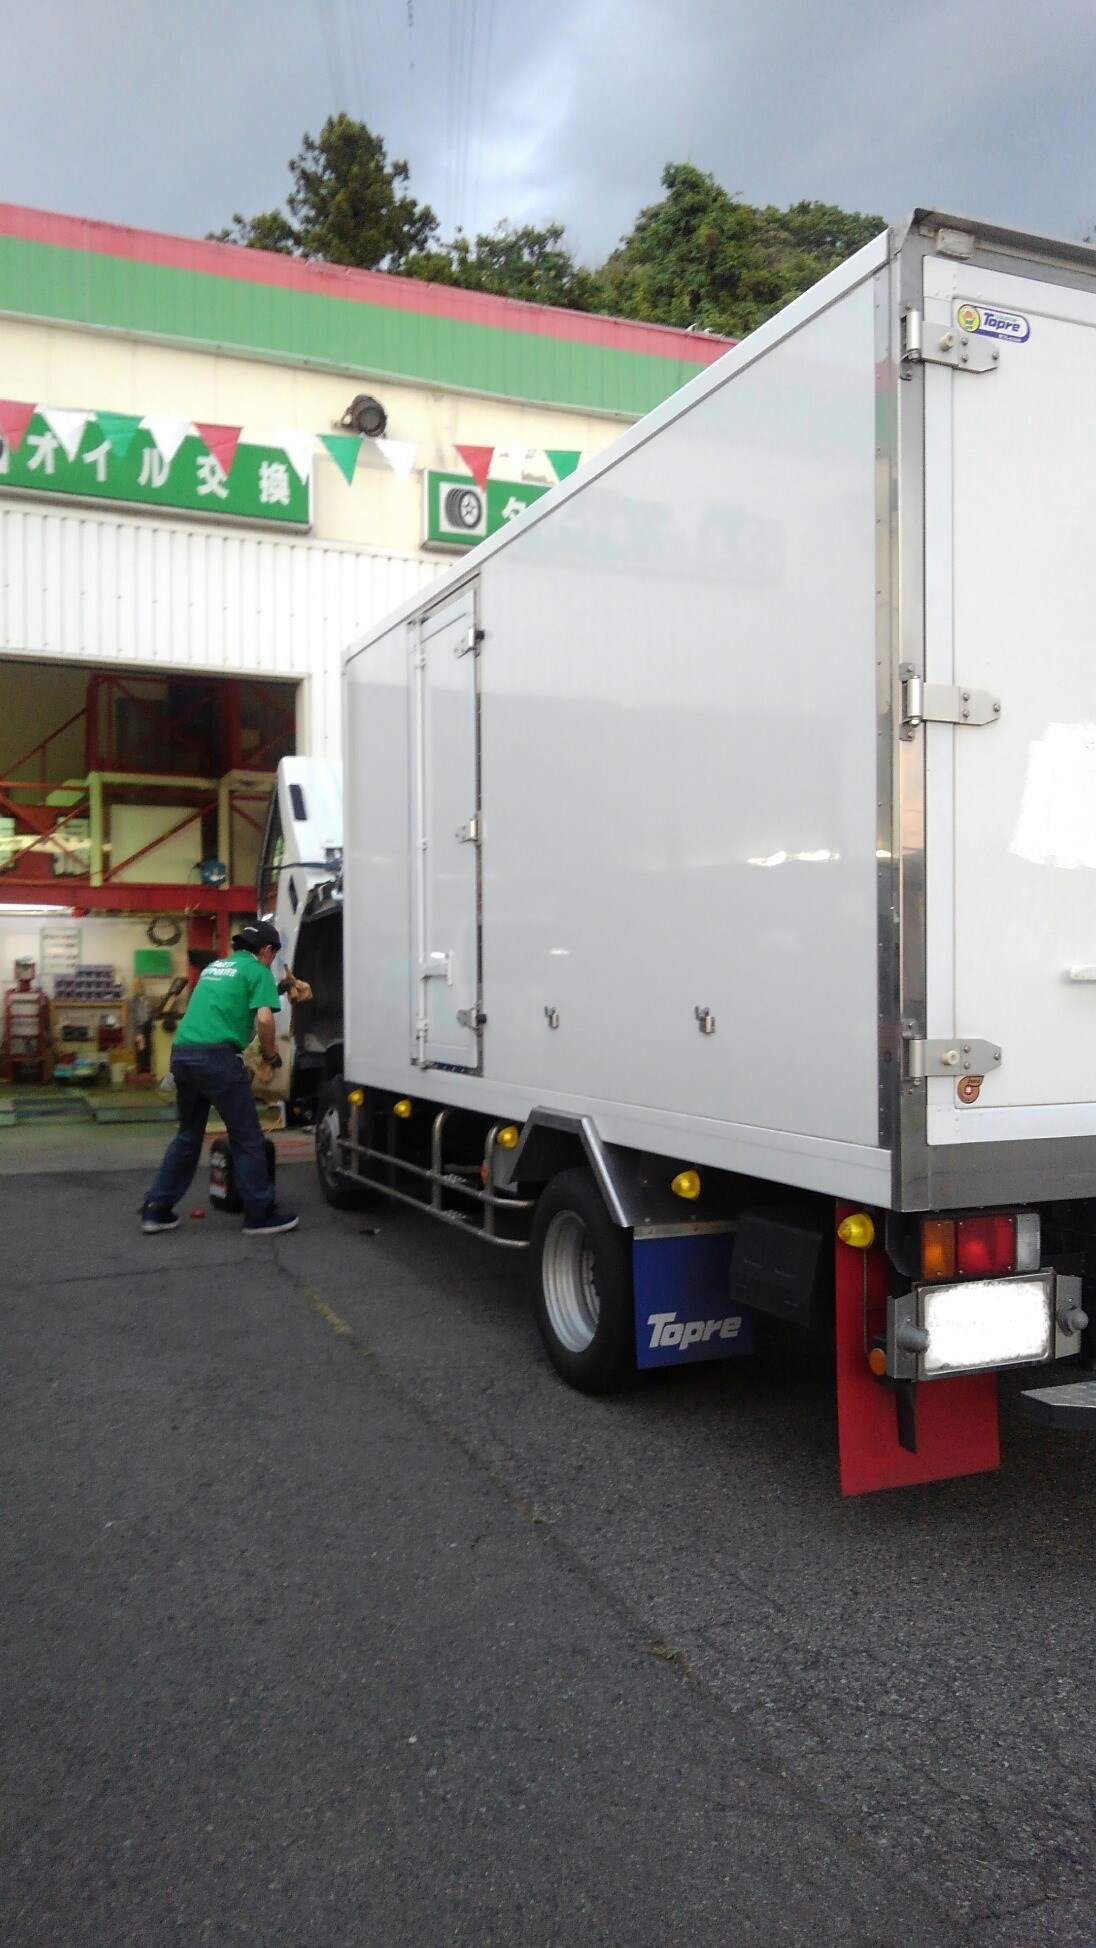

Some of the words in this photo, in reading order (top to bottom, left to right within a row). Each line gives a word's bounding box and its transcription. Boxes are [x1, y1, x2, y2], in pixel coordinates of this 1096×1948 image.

[983, 312, 1020, 332] Topre
[27, 431, 291, 506] オイル交換
[647, 1312, 742, 1350] Topre
